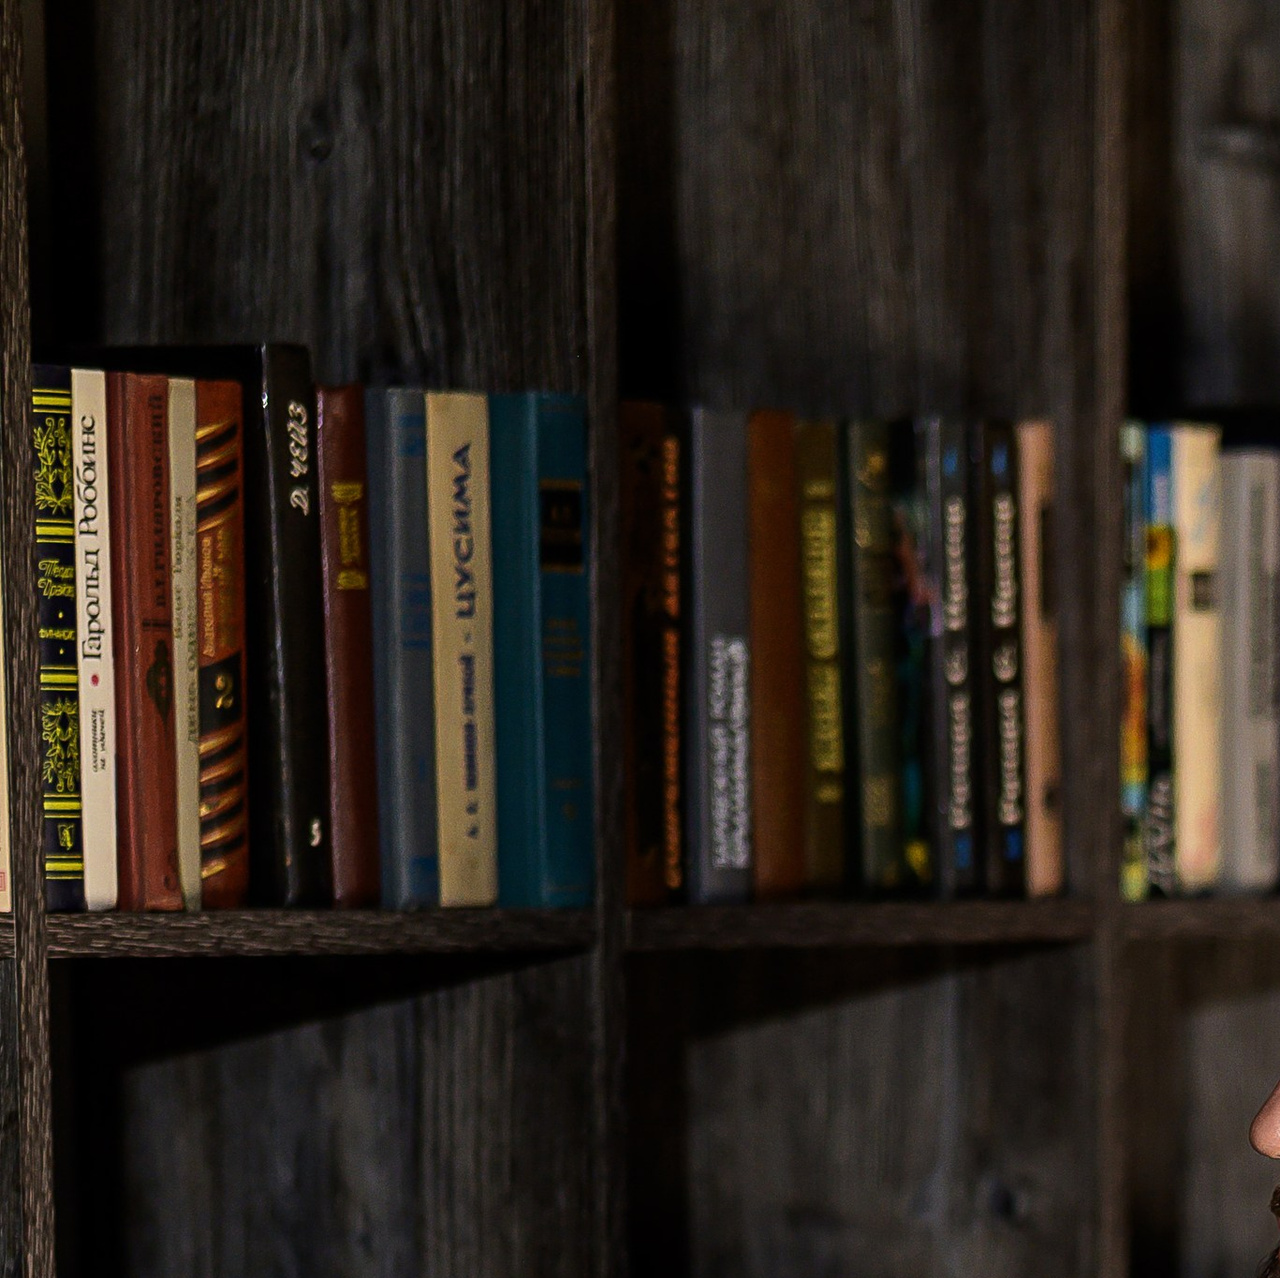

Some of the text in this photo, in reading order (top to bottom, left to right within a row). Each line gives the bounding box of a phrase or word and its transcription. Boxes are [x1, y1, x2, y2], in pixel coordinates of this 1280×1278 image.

[287, 401, 308, 478] ЧЕЙЗ
[76, 414, 105, 659] Гарольд Роббинс
[452, 442, 476, 620] ЦУСИМА
